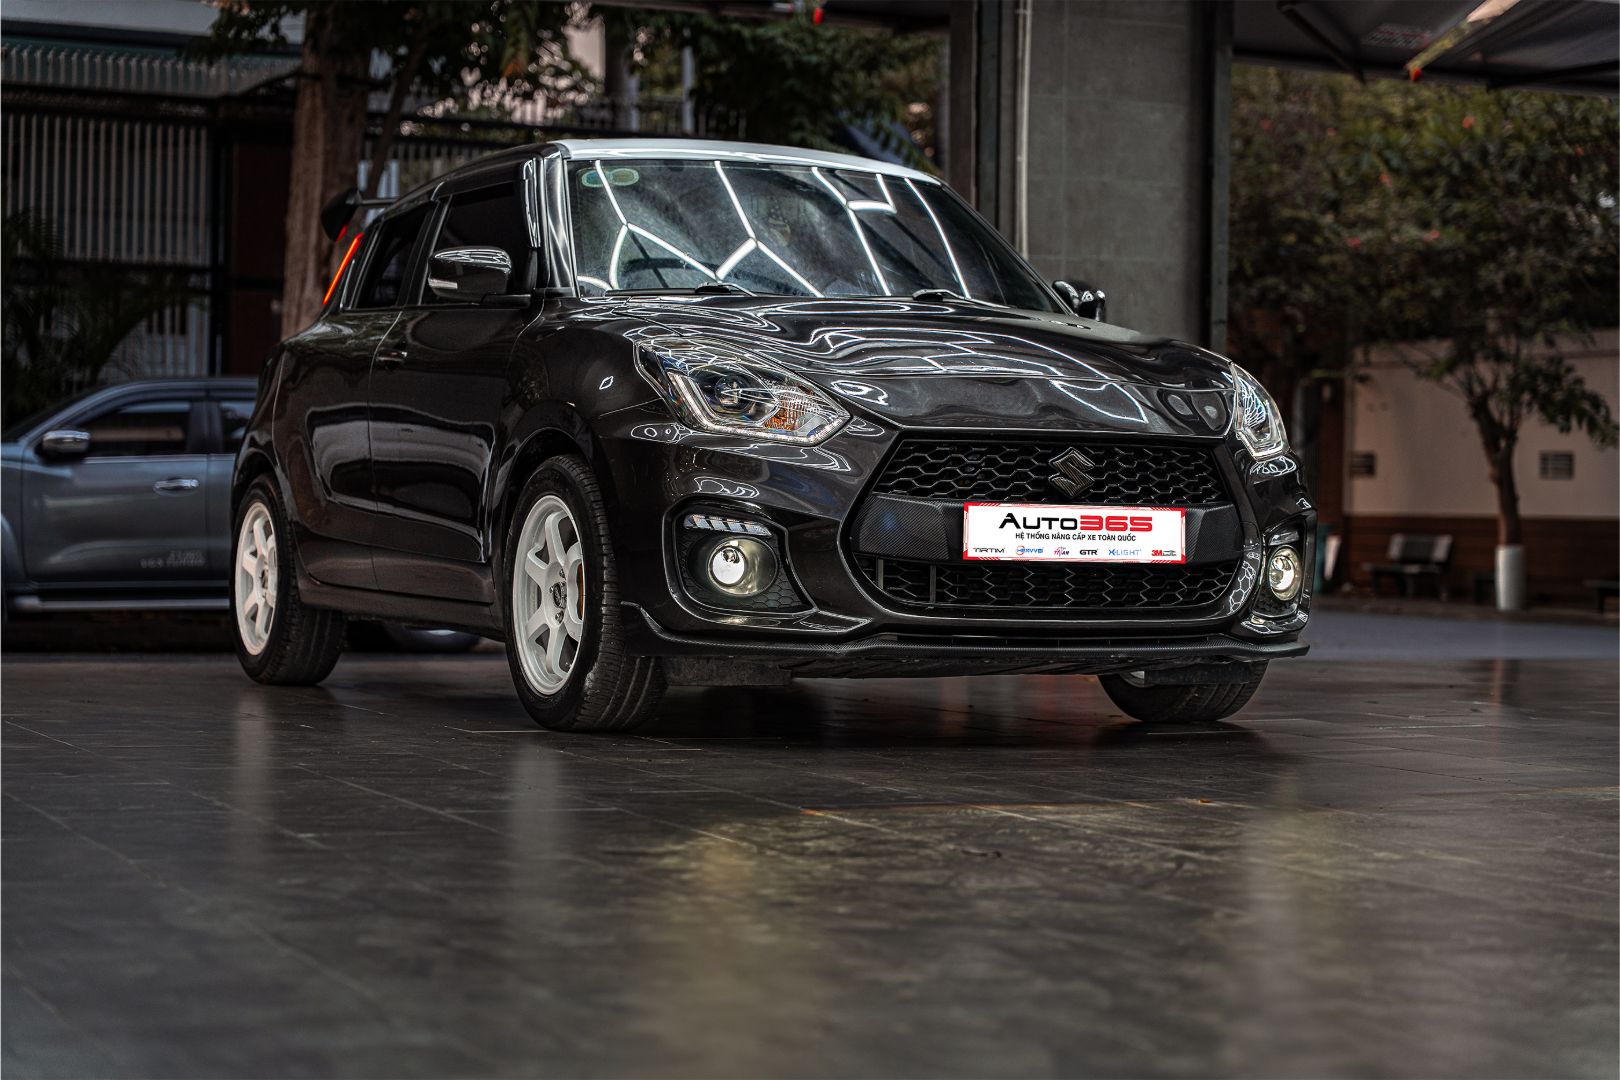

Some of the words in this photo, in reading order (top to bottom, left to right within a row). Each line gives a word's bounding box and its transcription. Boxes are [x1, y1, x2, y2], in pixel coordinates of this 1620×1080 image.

[1015, 532, 1024, 541] HỆ
[1026, 531, 1050, 540] THỐNG
[1051, 532, 1071, 541] NÂNG
[1072, 532, 1086, 541] CẤP
[1098, 533, 1116, 541] TOÀN
[1117, 532, 1136, 542] QUỐC
